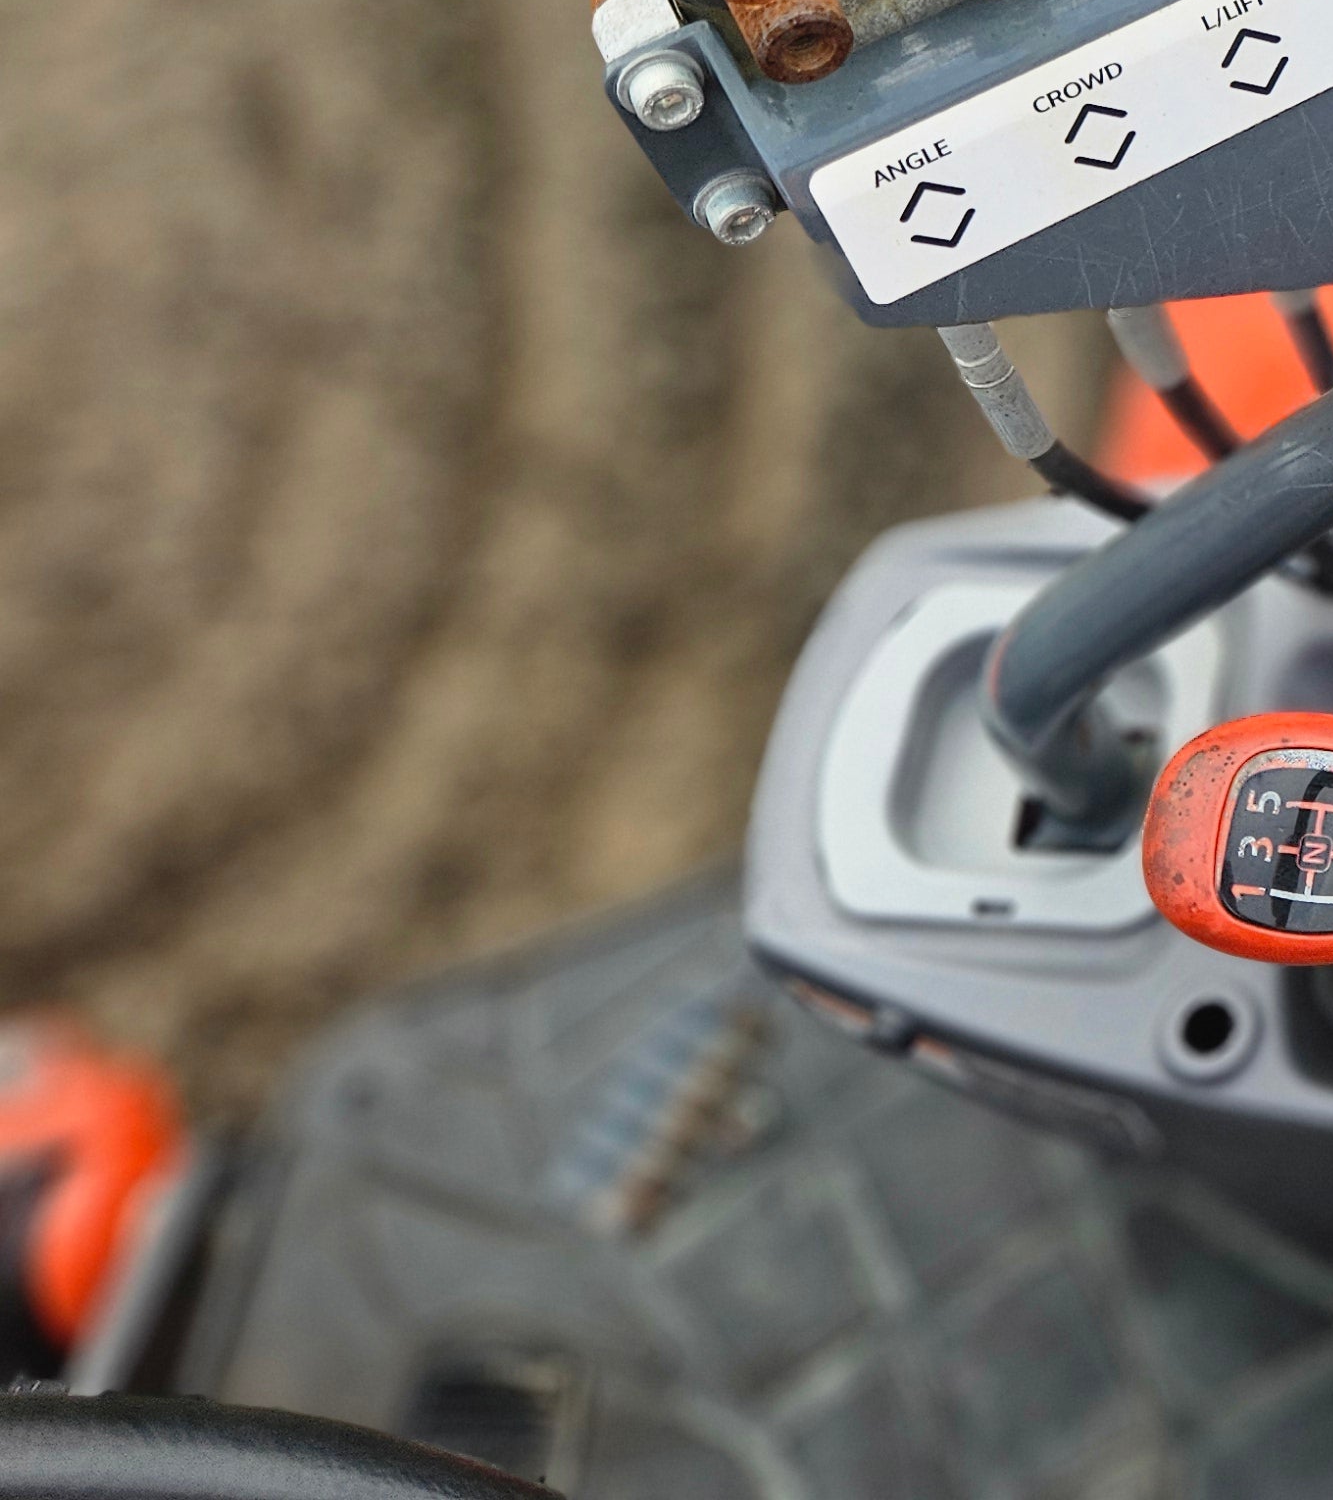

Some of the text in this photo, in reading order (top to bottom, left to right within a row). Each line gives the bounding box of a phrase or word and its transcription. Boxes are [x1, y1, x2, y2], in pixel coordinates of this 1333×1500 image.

[1032, 62, 1123, 113] CROWD
[873, 138, 953, 189] ANGLE
[1246, 790, 1282, 816] 5
[1237, 836, 1274, 863] 3
[1302, 842, 1328, 865] N
[1231, 884, 1267, 900] 1
